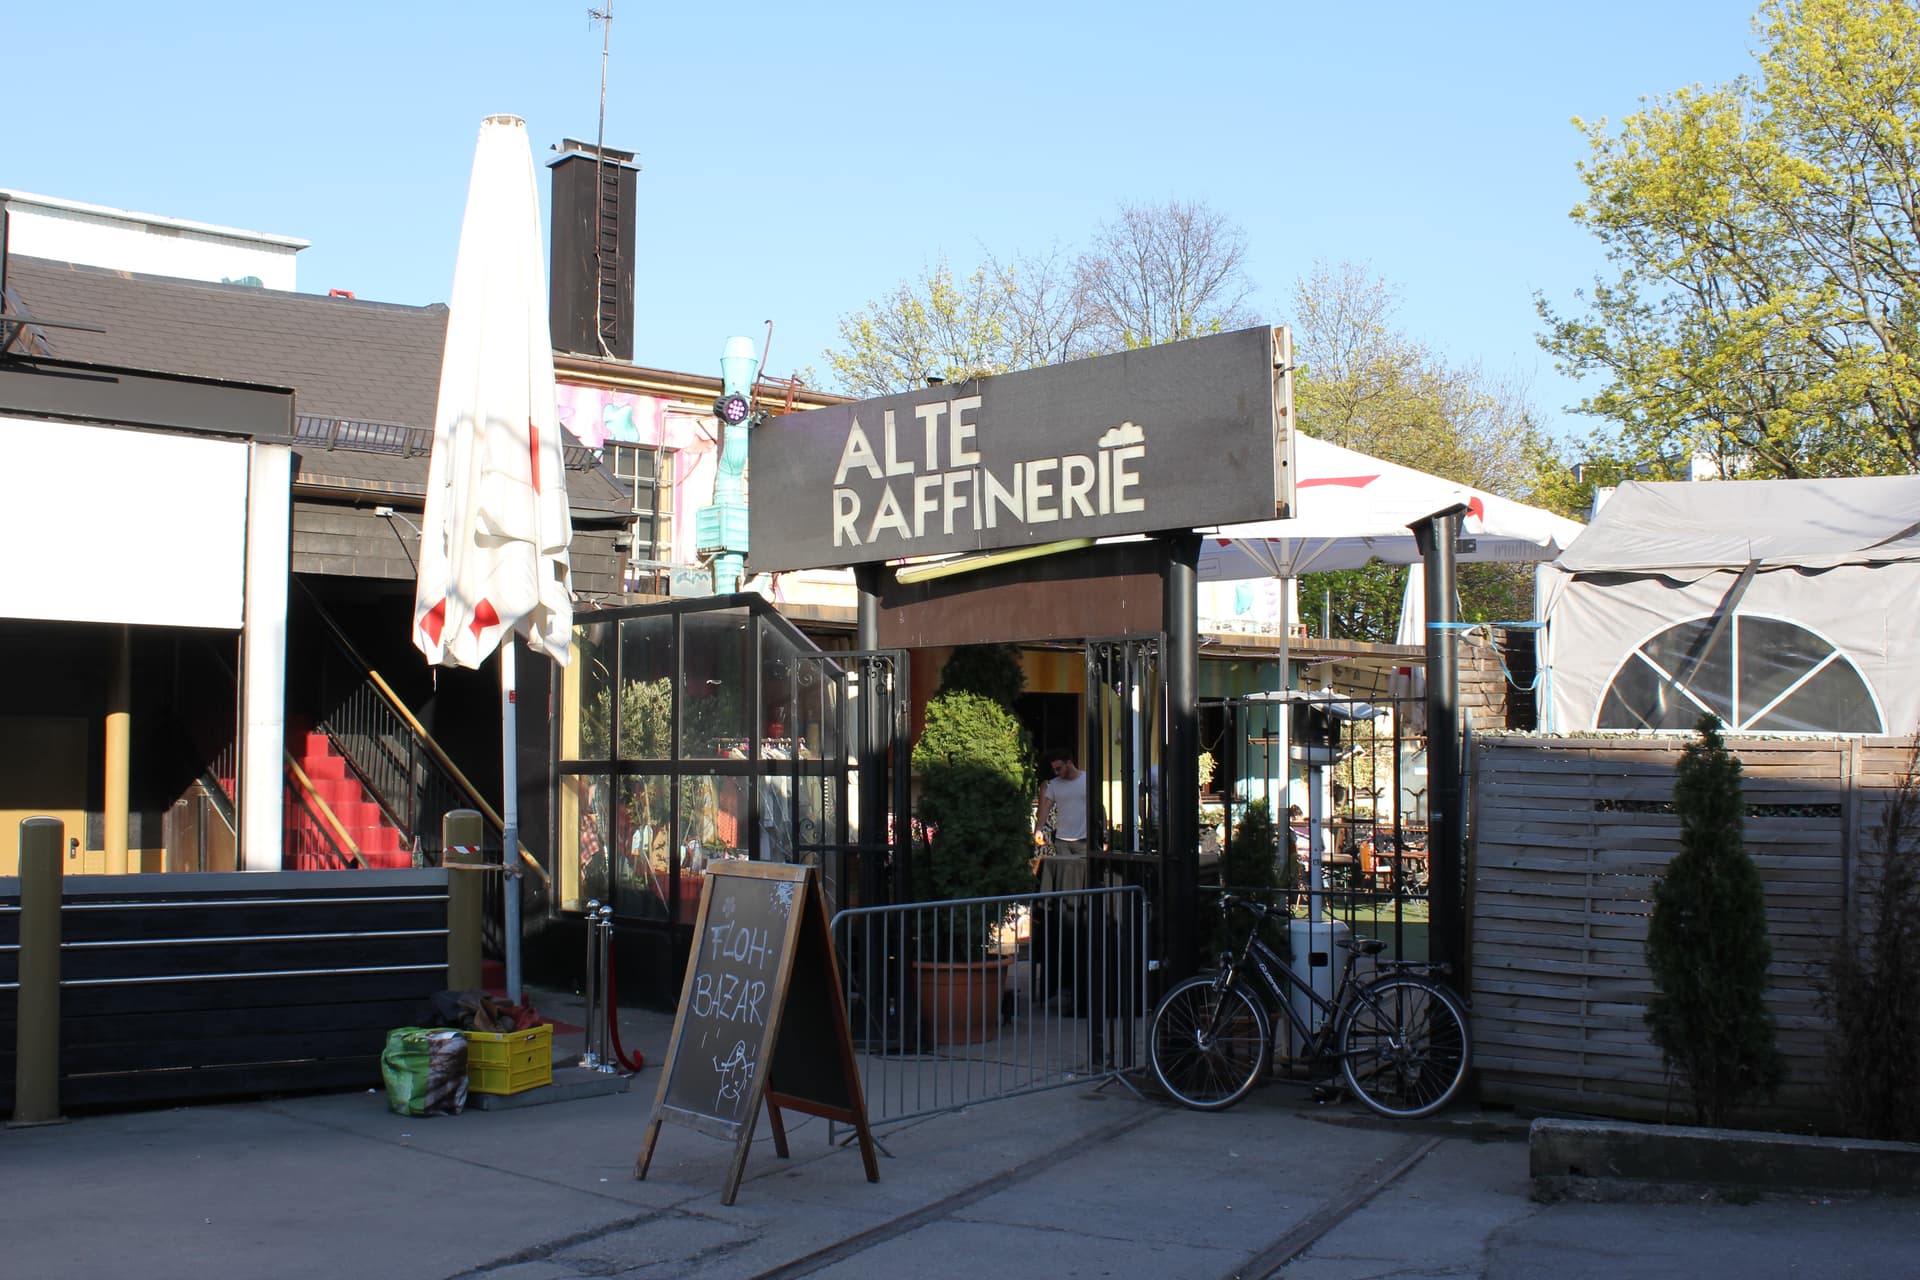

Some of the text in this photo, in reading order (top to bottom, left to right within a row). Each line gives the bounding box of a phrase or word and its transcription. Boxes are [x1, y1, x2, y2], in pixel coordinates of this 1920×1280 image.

[833, 395, 982, 485] ALTE
[832, 444, 1146, 547] RAFFINERIE
[692, 973, 764, 1026] BAZAR
